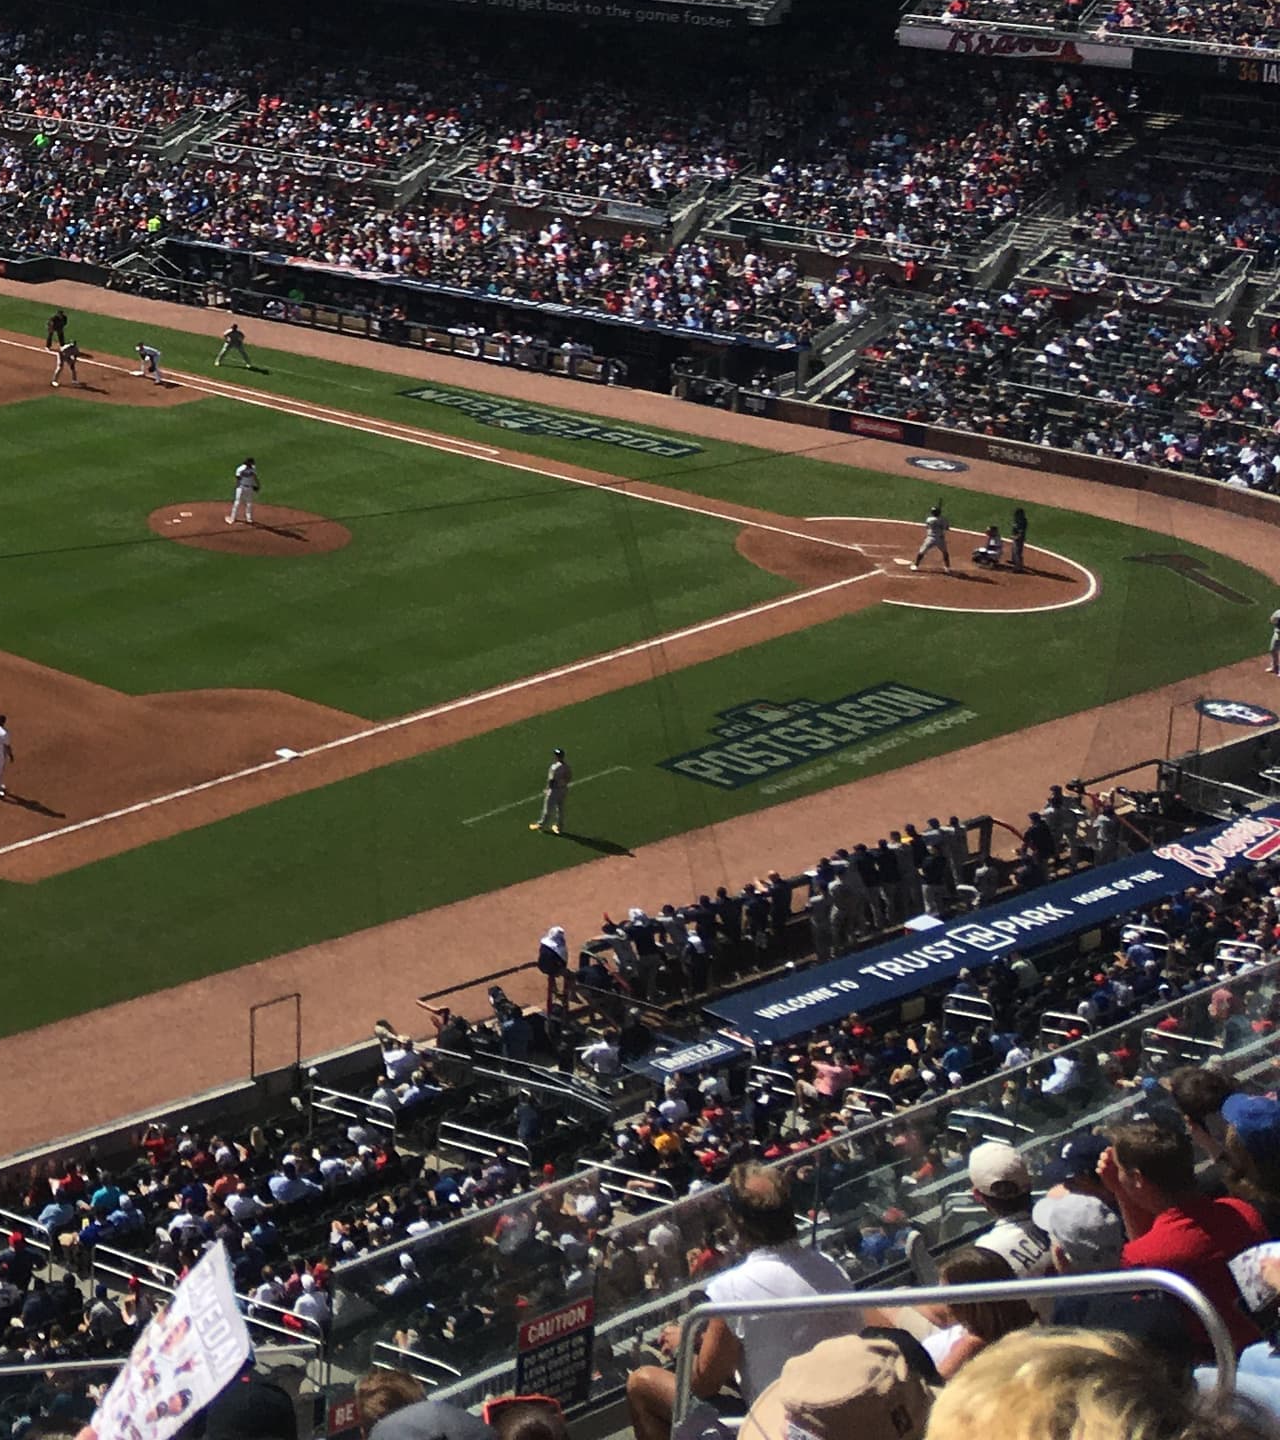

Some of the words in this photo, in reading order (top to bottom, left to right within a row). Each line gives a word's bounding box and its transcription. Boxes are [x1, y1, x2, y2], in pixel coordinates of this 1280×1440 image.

[672, 684, 949, 786] POSTSEASON
[754, 983, 838, 1020] WELCOME
[831, 978, 860, 995] TO
[859, 940, 968, 983] TRUIST
[994, 901, 1074, 937] PARK
[1071, 885, 1116, 905] HOME
[1113, 879, 1136, 893] OF
[1152, 817, 1274, 878] Braves
[527, 1304, 587, 1344] CAUTION
